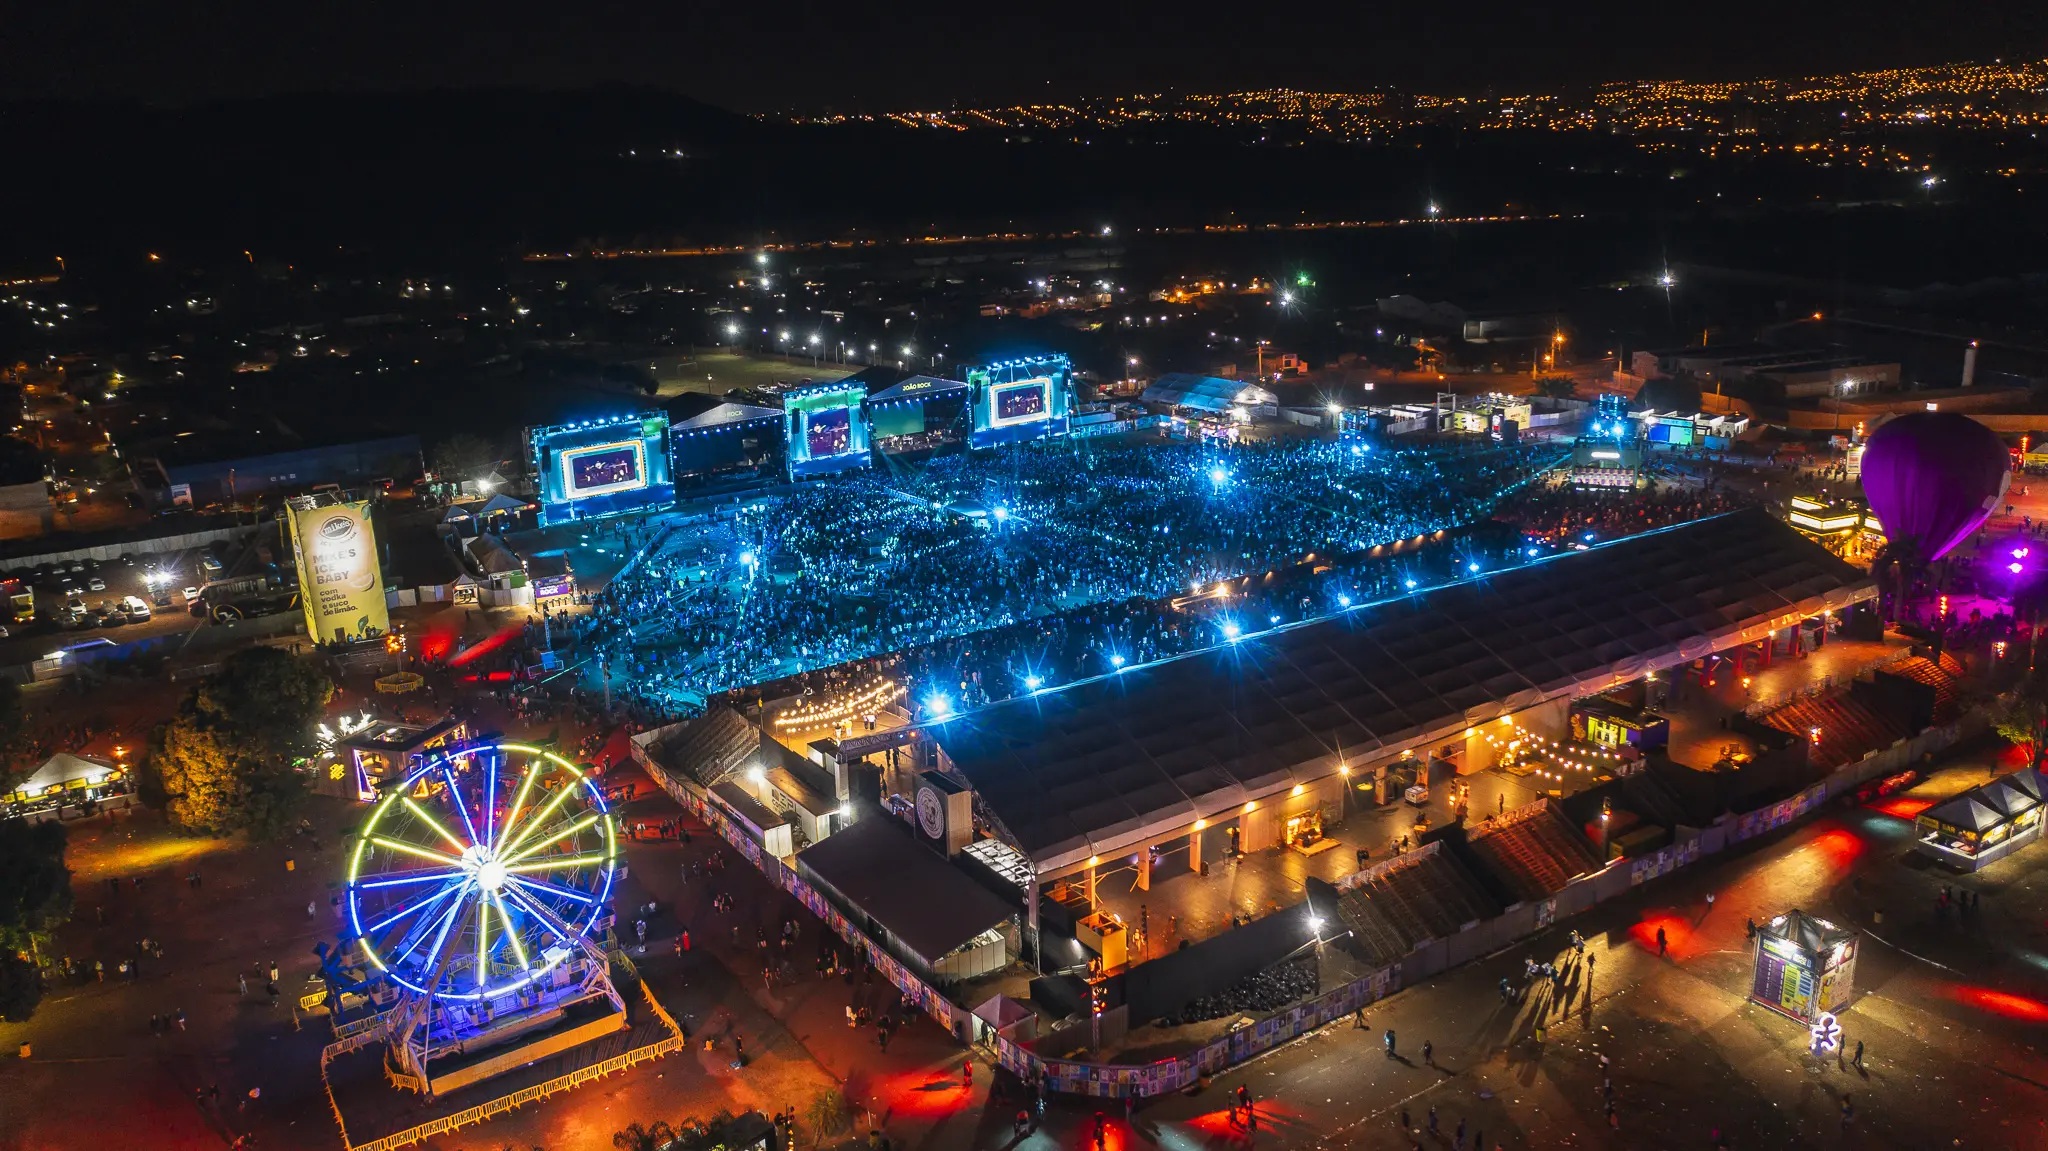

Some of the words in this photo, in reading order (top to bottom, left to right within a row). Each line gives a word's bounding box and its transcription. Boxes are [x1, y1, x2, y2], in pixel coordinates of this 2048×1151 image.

[902, 383, 917, 392] JOÃO
[917, 381, 932, 389] ROCK
[726, 409, 743, 417] ROCK
[312, 548, 357, 564] MIKE'S
[314, 563, 335, 574] ICE
[316, 570, 349, 585] BABY
[319, 588, 338, 597] com
[320, 593, 346, 603] vodka
[328, 600, 349, 609] suco
[323, 607, 334, 616] de
